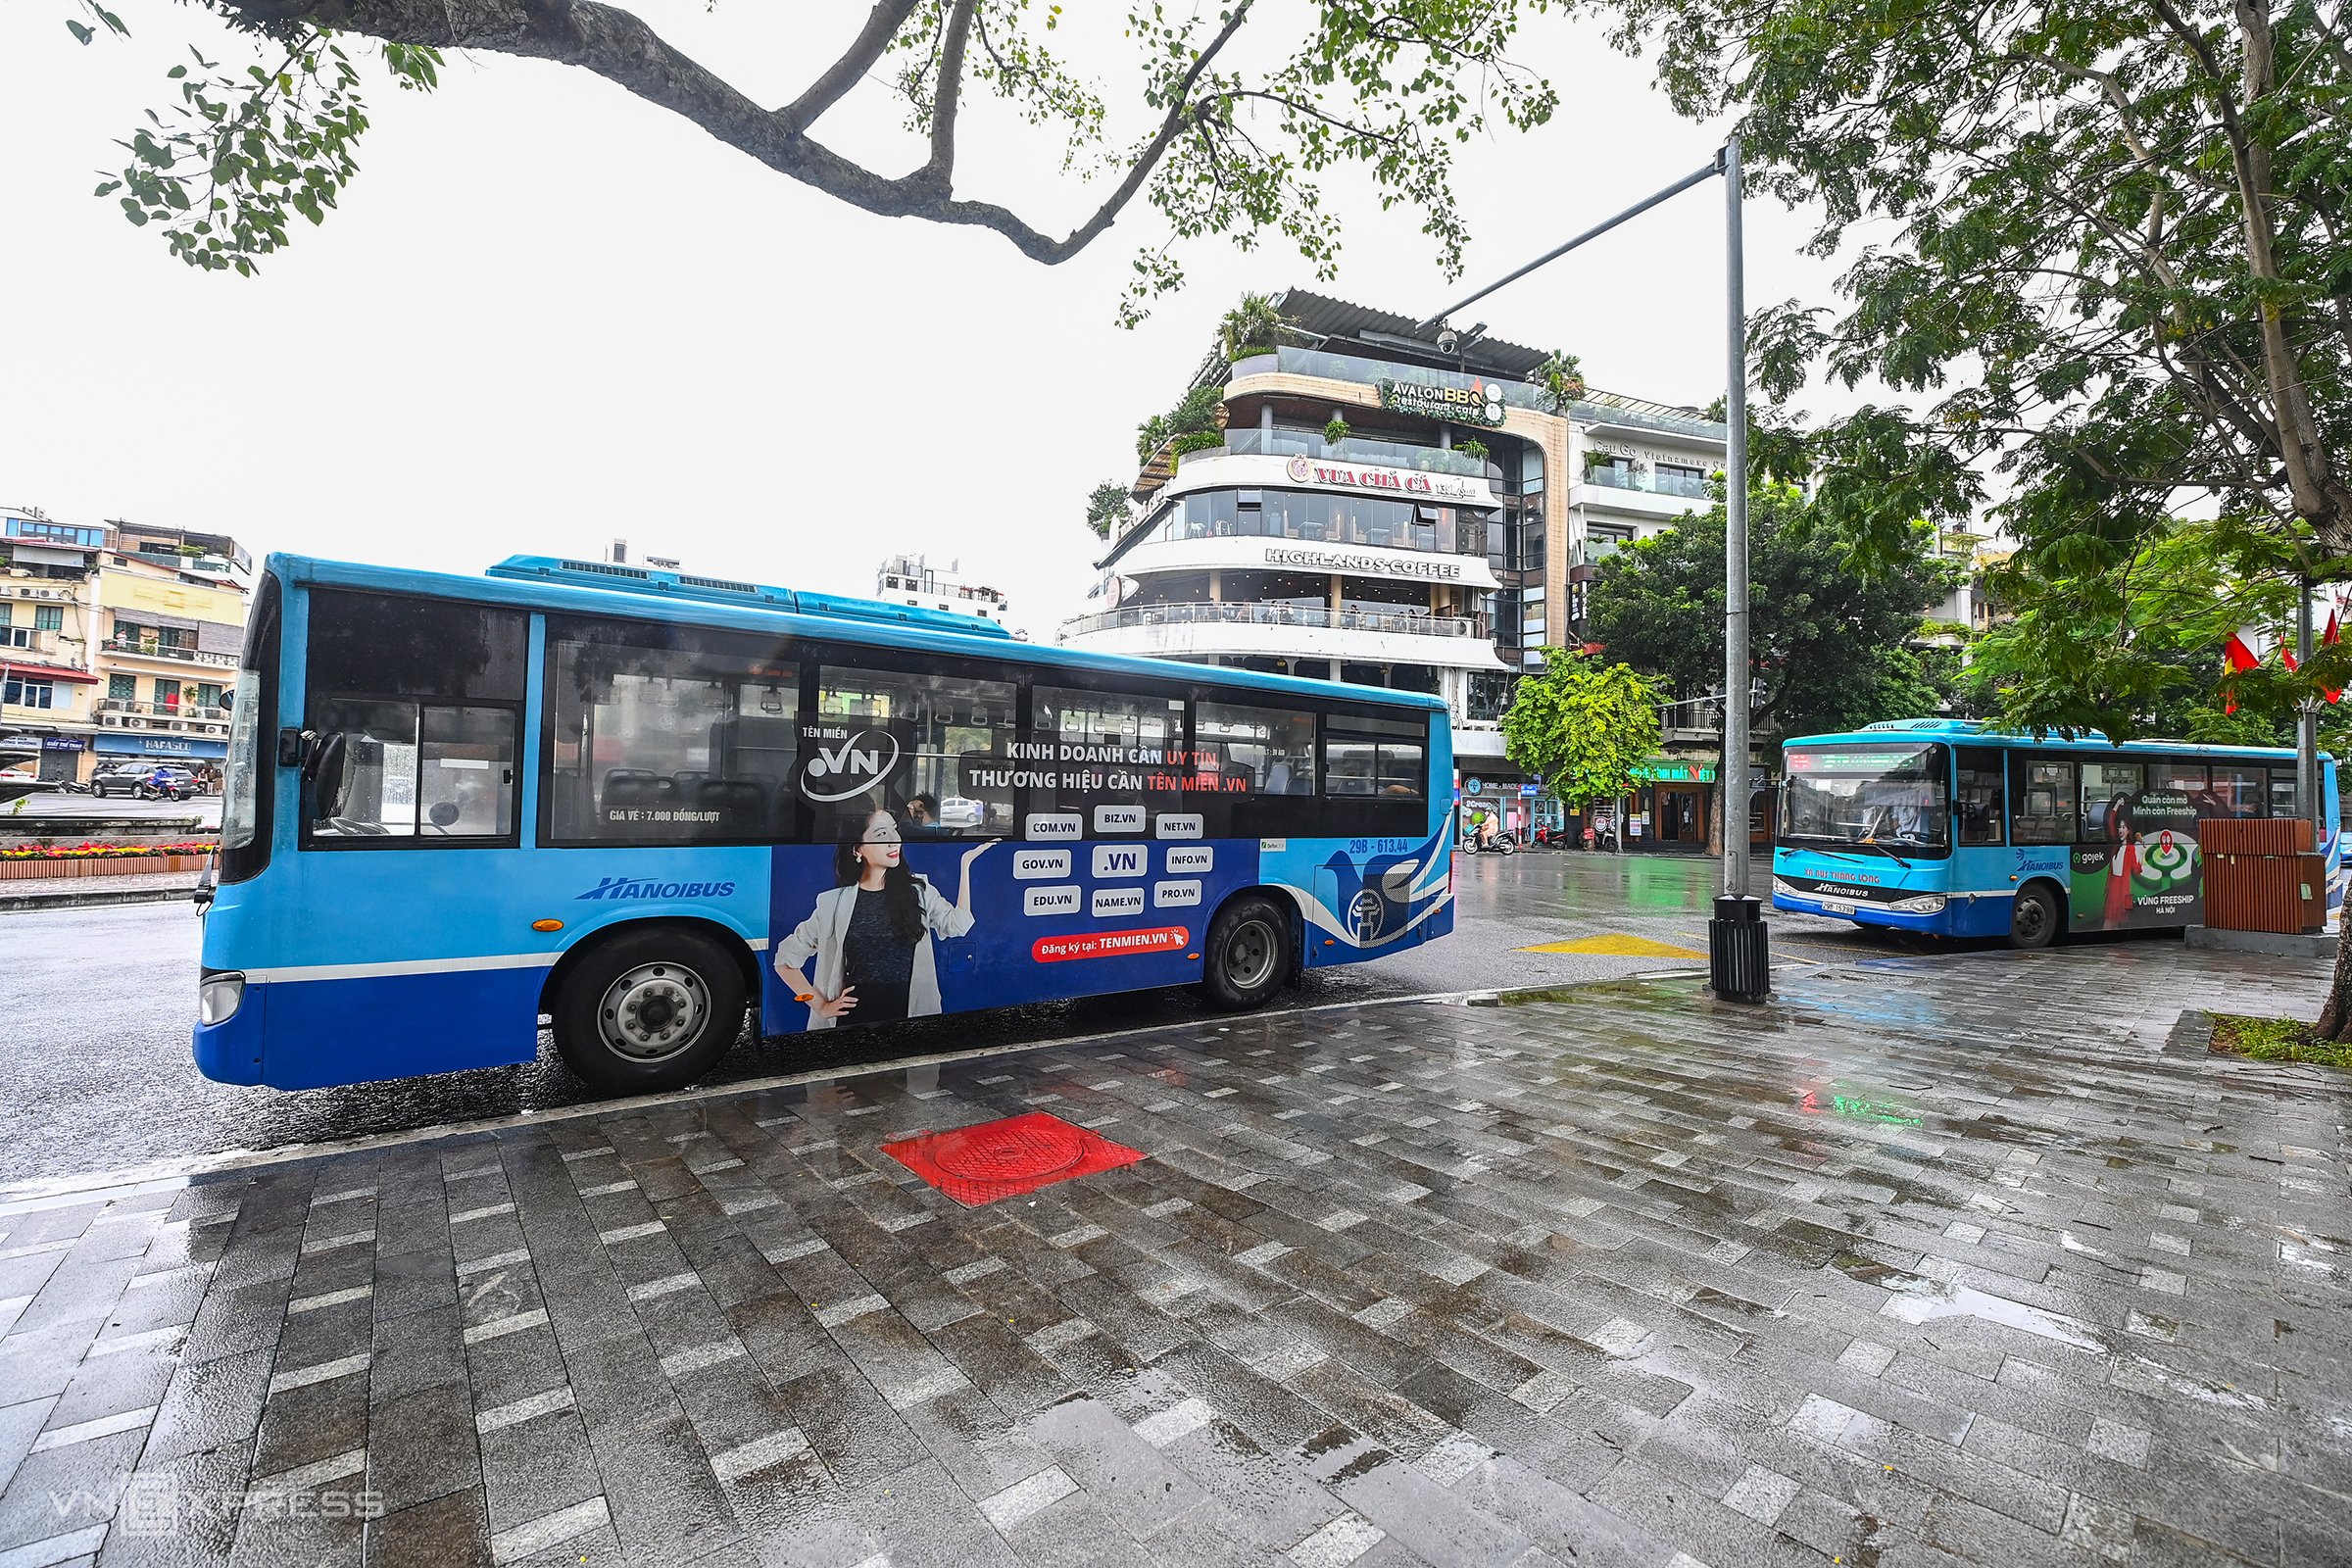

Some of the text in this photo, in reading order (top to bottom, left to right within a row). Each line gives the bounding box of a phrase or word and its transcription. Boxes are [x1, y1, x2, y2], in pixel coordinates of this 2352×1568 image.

[1392, 383, 1444, 401] AVALON
[1396, 396, 1450, 412] restaurant
[1643, 451, 1708, 467] Vietnamese
[1316, 467, 1356, 485] VUA
[1265, 548, 1460, 578] HIGHLANDS COFFEE
[803, 725, 820, 738] TÊN
[1006, 742, 1054, 760] KINH
[1059, 744, 1124, 763] DOANH
[1128, 743, 1162, 765] CẦN
[1167, 751, 1189, 765] UY
[969, 769, 1057, 789] THƯƠNG
[1062, 769, 1102, 794] HIỆU
[1107, 769, 1142, 791] CẦN
[1147, 771, 1176, 791] TÊN
[1223, 776, 1247, 793] .VN
[647, 810, 671, 821] 7.000
[2167, 806, 2197, 817] Freeship
[1104, 813, 1137, 824] BIZ.VN
[1033, 822, 1076, 833] COM.VN
[1164, 821, 1197, 832] NET.VN
[1349, 840, 1368, 854] 29B
[1377, 839, 1408, 854] 613.44
[1022, 858, 1063, 870] GOV.VN
[1103, 853, 1137, 872] .VN
[1171, 855, 1207, 865] INFO.VN
[2082, 852, 2105, 864] gojek
[2017, 859, 2064, 872] HANOIBUS
[1816, 869, 1829, 878] BUS
[1859, 874, 1881, 884] LONG
[573, 877, 736, 901] HANOIBUS
[1161, 888, 1196, 900] PRO.VN
[1814, 883, 1869, 897] HANOIBUS
[1033, 895, 1073, 906] EDU.VN
[1096, 896, 1142, 908] NAME.VN
[2137, 895, 2194, 906] VÙNG FREESHIP
[2156, 906, 2176, 915] HÀ NỘI
[1041, 933, 1167, 956] Đăng ký tại: TENMIEN.VN
